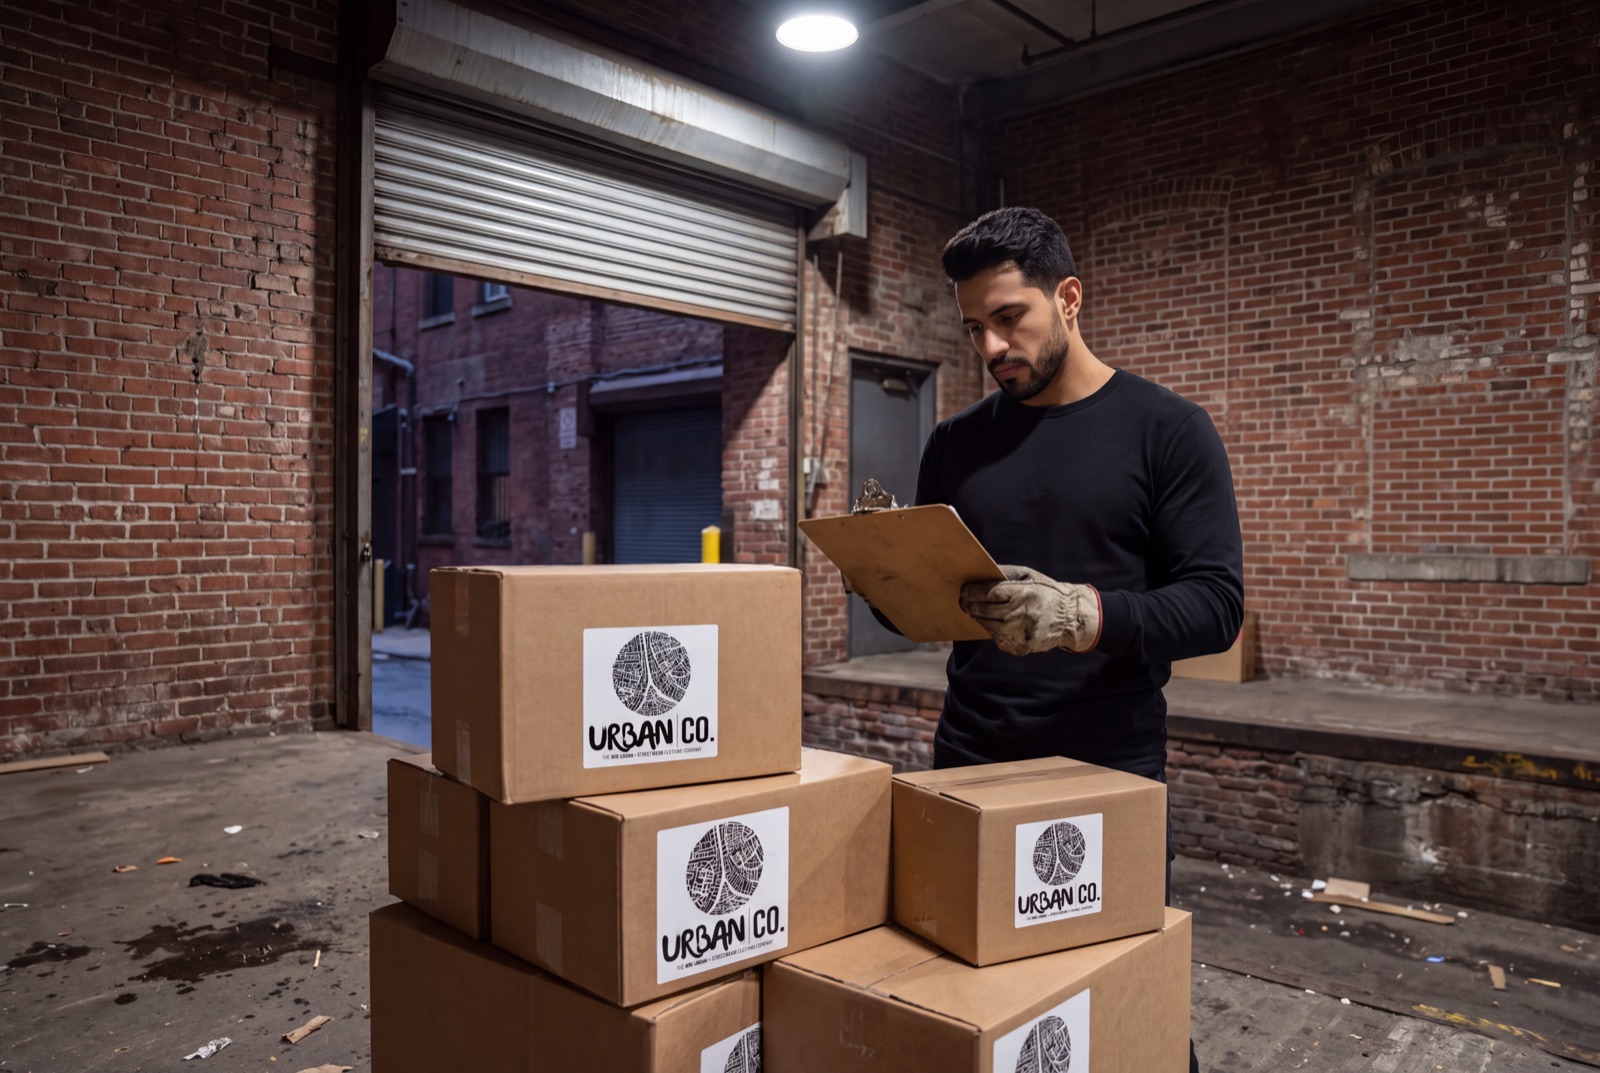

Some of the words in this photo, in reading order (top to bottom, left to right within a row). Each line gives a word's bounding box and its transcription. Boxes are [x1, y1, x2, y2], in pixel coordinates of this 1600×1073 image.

[589, 719, 673, 752] URBAN
[682, 716, 715, 743] CO.
[1018, 886, 1074, 914] URBAN
[1078, 882, 1101, 904] CO.
[662, 915, 745, 962] URBAN
[753, 905, 785, 938] CO.
